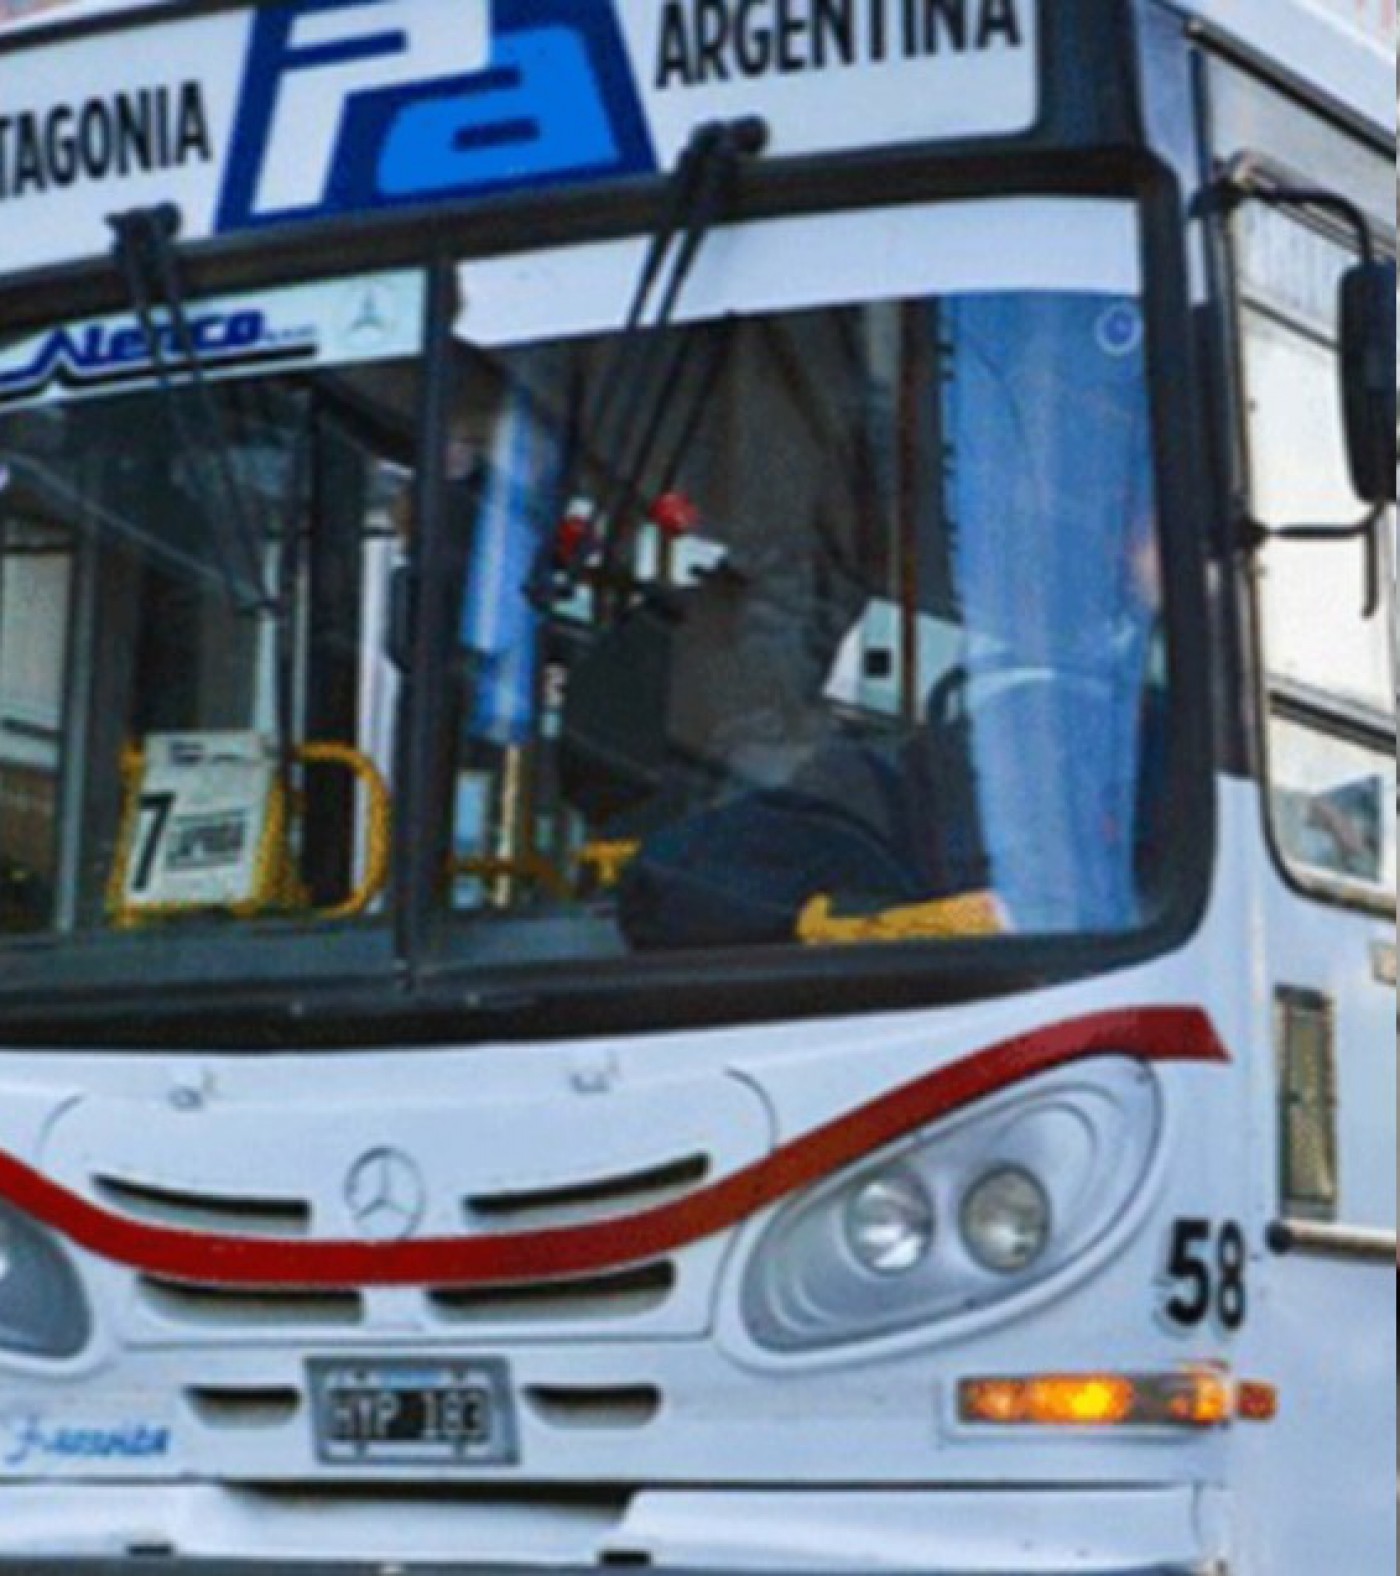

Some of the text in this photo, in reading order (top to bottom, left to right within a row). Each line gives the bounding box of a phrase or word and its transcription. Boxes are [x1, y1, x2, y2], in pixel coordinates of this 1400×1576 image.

[653, 0, 1022, 89] ARGENTINA
[0, 309, 265, 386] Alenco
[133, 791, 176, 893] 7
[1164, 1218, 1246, 1330] 58
